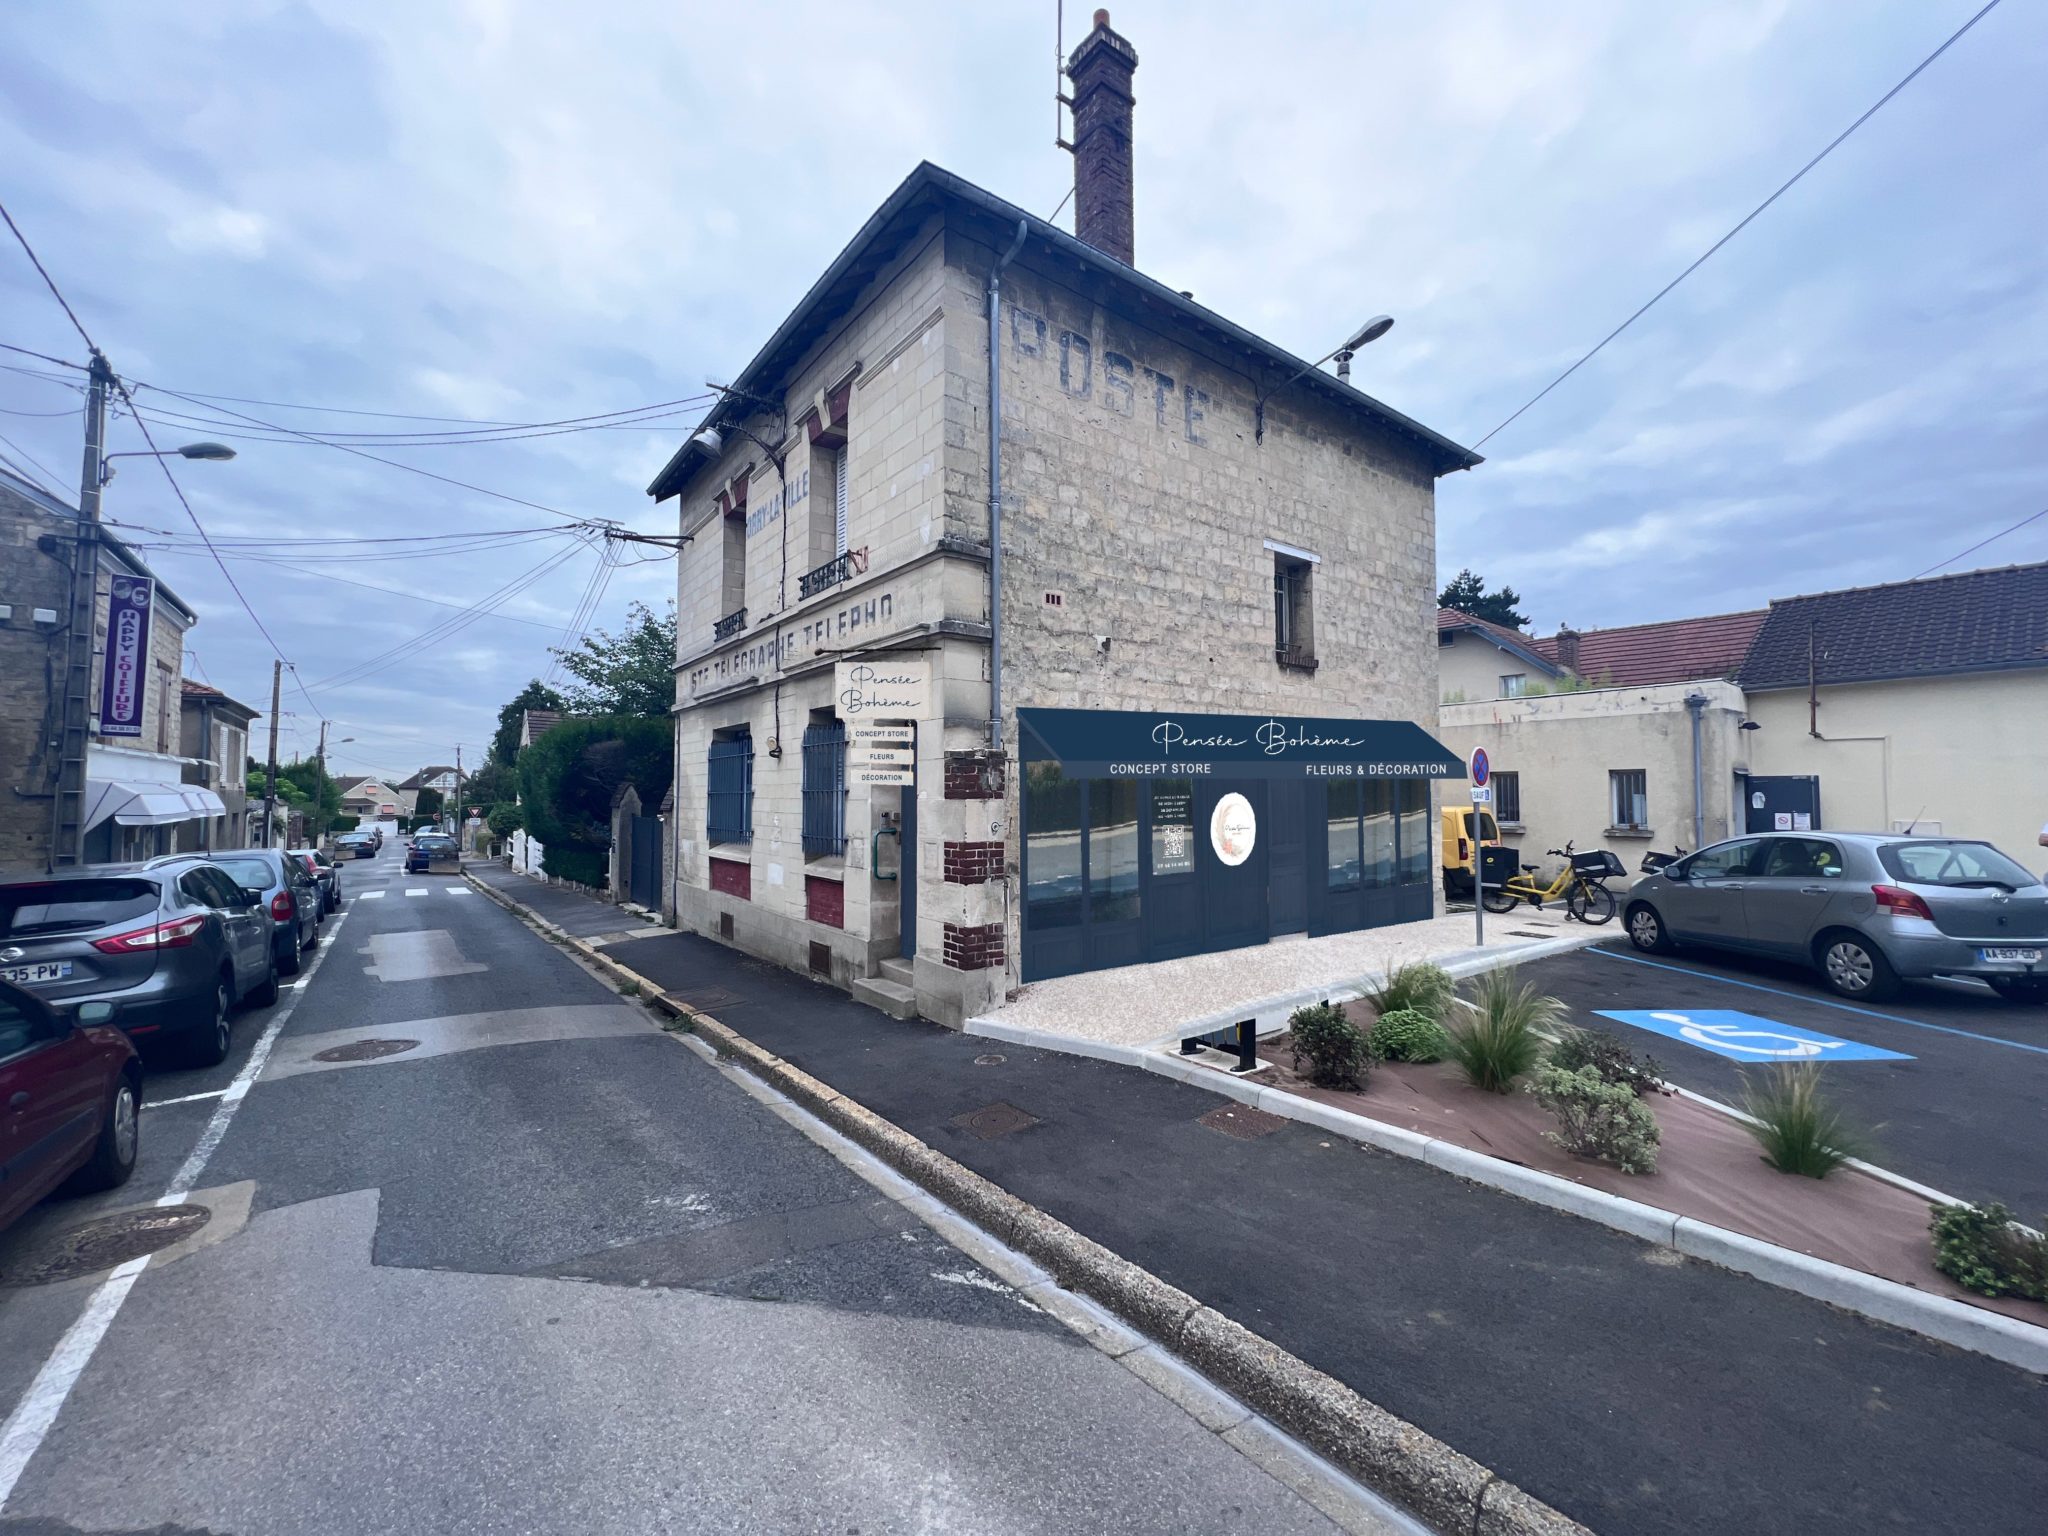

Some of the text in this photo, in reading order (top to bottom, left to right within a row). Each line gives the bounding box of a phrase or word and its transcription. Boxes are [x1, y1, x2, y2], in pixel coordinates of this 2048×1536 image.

[1011, 306, 1210, 446] POSTE
[120, 611, 135, 651] HAPPY
[115, 655, 132, 720] COIFFURE
[850, 665, 921, 690] Pensée
[840, 687, 921, 713] Bohème
[855, 730, 885, 738] CONCEPT
[1152, 718, 1366, 755] Pensée Bohème
[861, 773, 903, 781] DÉCORATION
[1109, 763, 1212, 775] CONCEPT STORE
[1306, 763, 1447, 775] FLEURS & DÉCORATION
